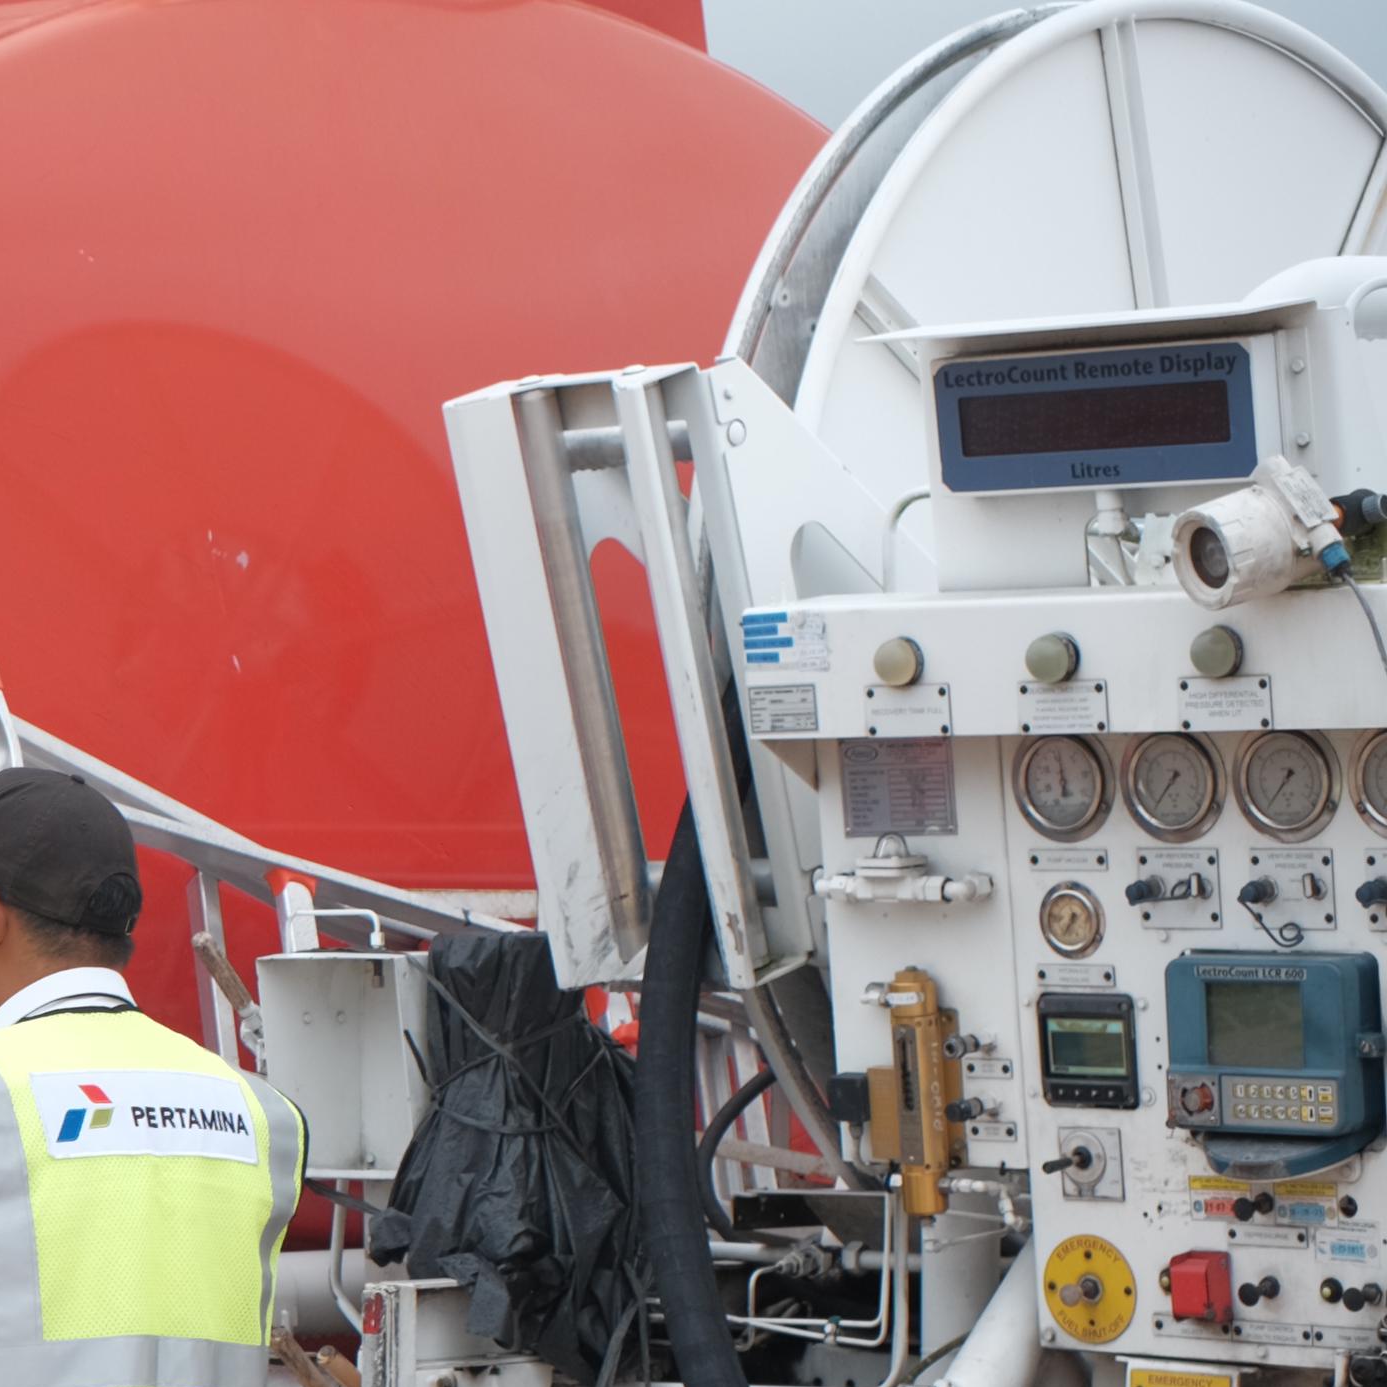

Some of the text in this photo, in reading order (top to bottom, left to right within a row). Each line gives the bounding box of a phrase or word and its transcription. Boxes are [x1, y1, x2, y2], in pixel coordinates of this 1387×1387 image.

[943, 351, 1238, 389] LectroCount Remote Display
[1070, 462, 1121, 480] Litres
[1196, 966, 1305, 980] LectroCount LCR 600
[131, 1106, 249, 1136] PERTAMINA
[1056, 1239, 1122, 1265] EMERGENCY
[1081, 1313, 1126, 1339] SHUT-OFF
